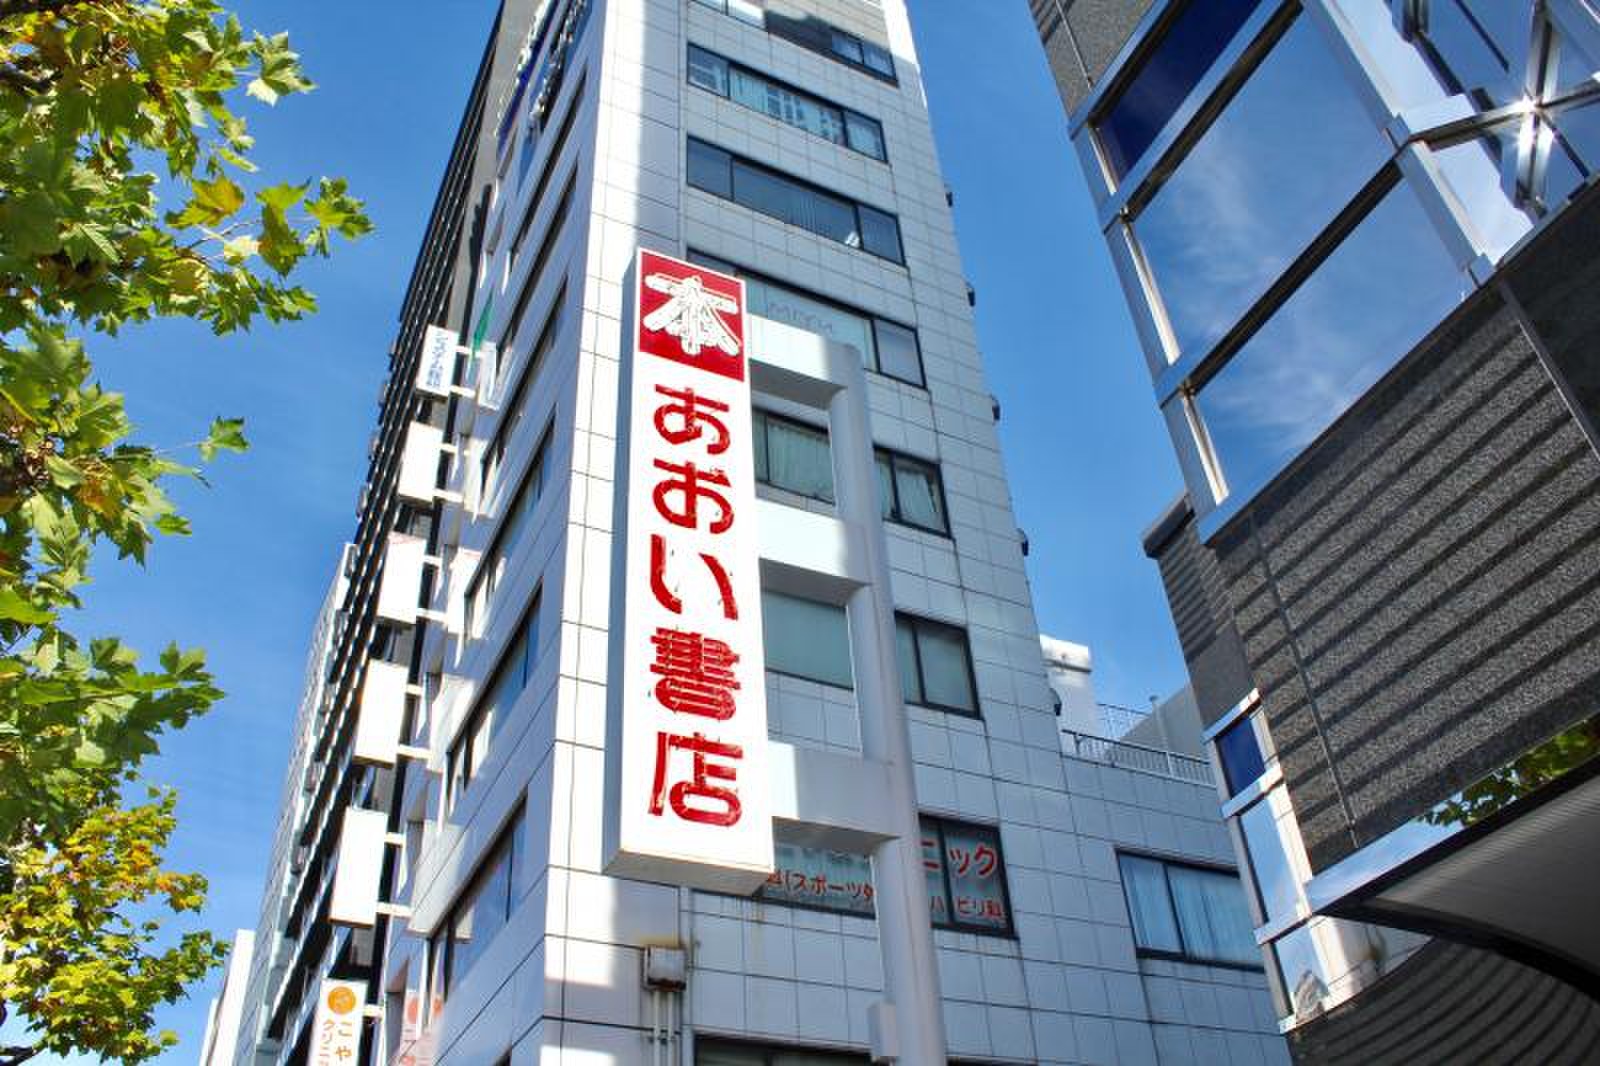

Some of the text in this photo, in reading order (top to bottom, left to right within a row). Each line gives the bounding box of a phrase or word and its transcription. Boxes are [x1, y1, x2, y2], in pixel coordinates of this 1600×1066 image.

[643, 273, 741, 356] 本
[648, 383, 743, 828] あおい書店
